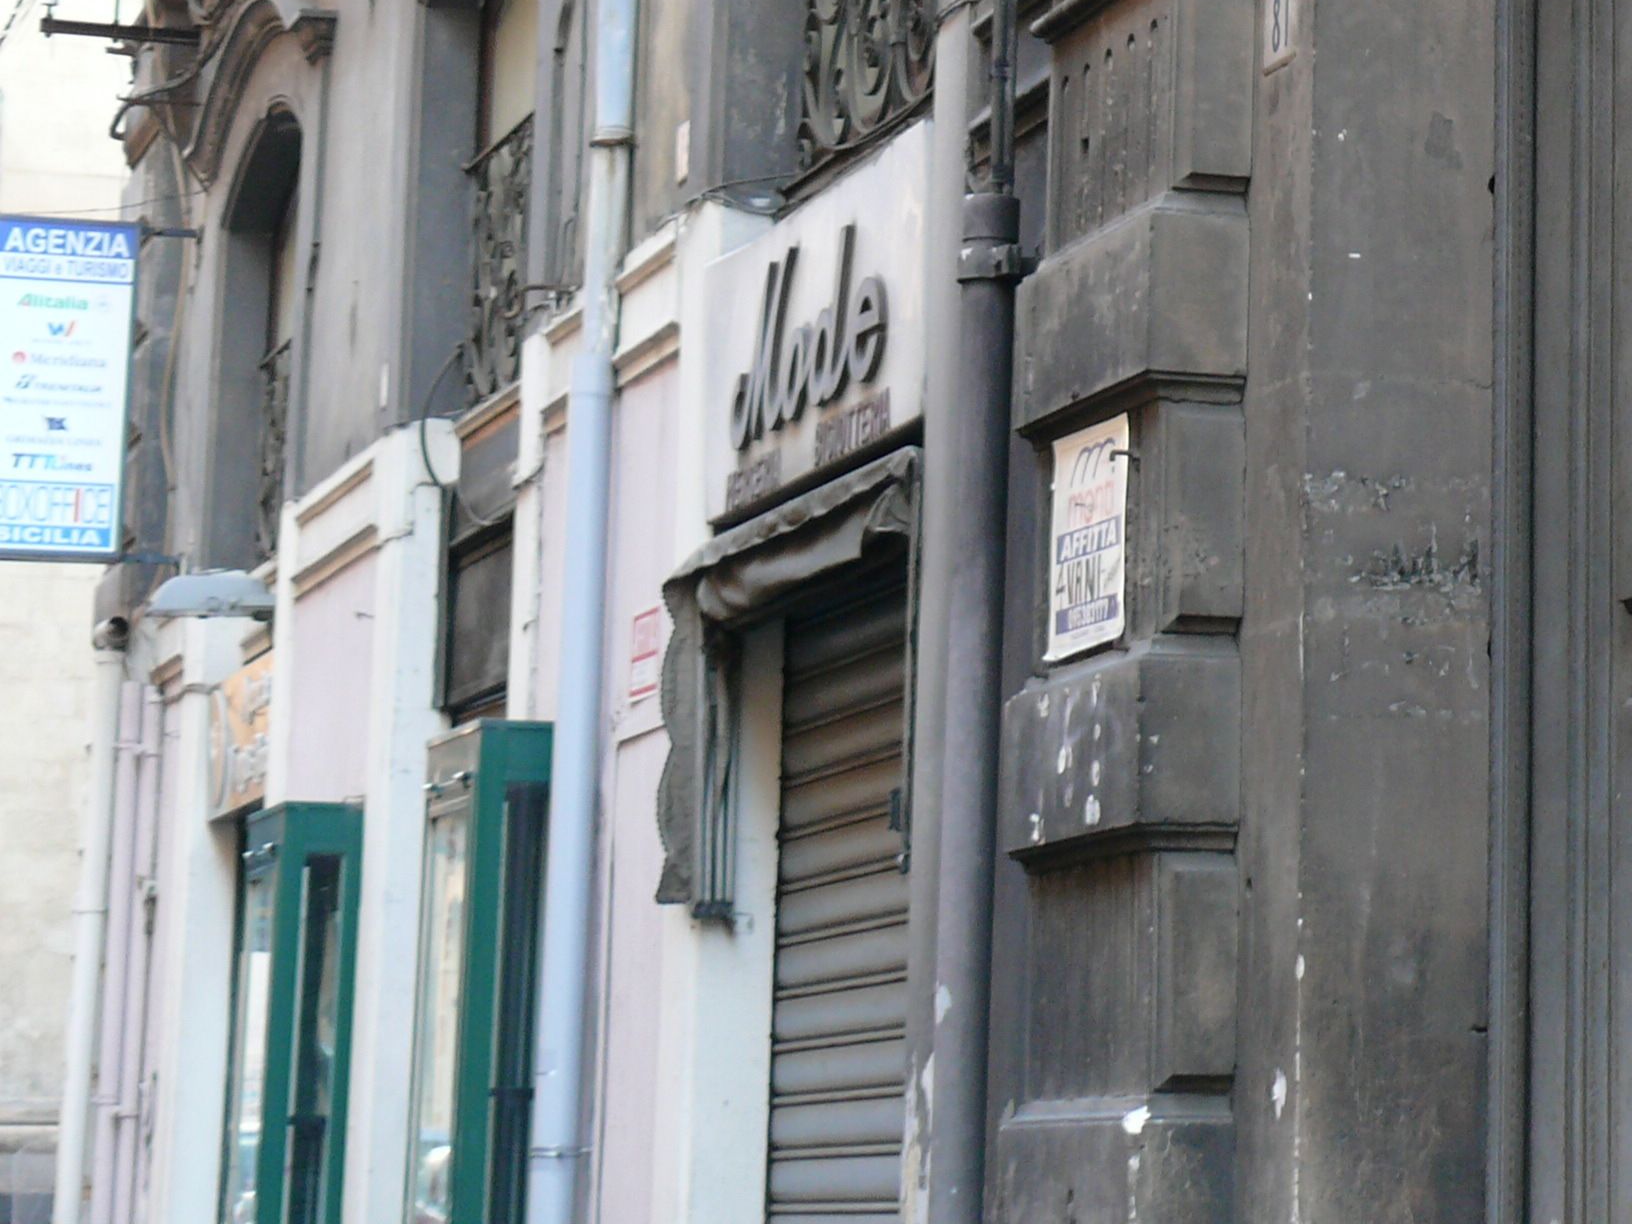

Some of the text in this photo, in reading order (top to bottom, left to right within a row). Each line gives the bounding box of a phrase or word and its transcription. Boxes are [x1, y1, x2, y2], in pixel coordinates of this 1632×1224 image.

[4, 226, 131, 259] AGENZIA
[17, 293, 89, 311] Alitalia
[730, 223, 890, 451] Mode
[1060, 518, 1118, 564] AFFITTA
